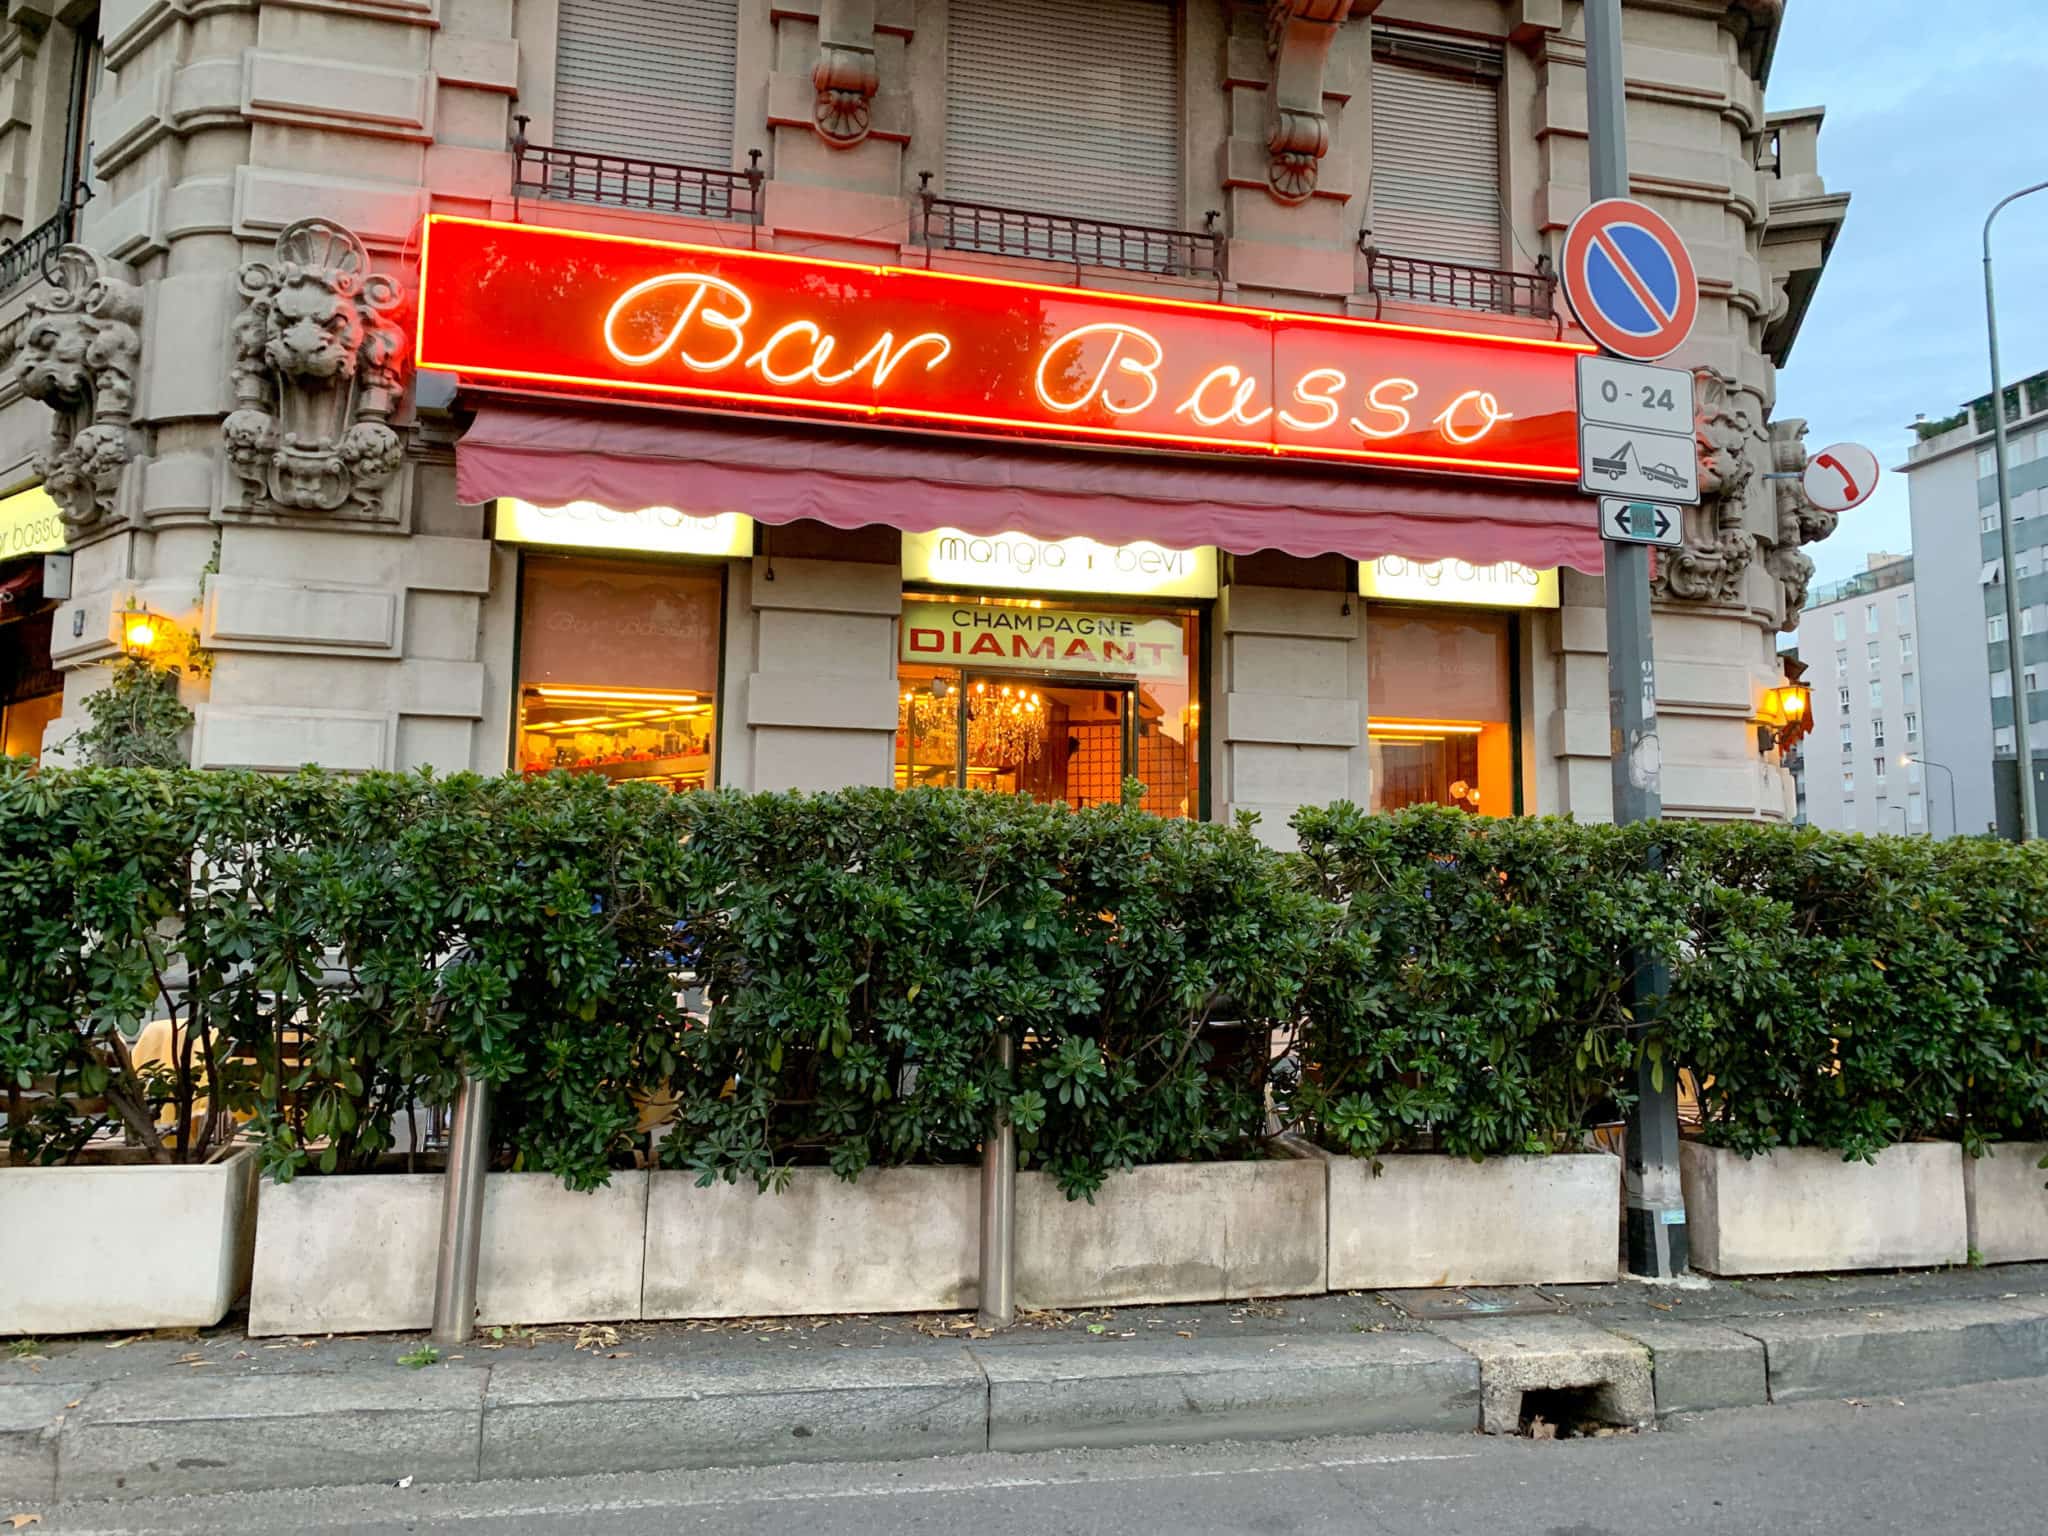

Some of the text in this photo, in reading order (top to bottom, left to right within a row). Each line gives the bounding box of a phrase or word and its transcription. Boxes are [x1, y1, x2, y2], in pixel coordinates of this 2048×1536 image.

[604, 271, 1513, 445] Bar Basso
[1601, 380, 1618, 403] 0
[1641, 385, 1675, 412] 24
[910, 609, 1175, 666] CHAMPAGNE DIAMANT
